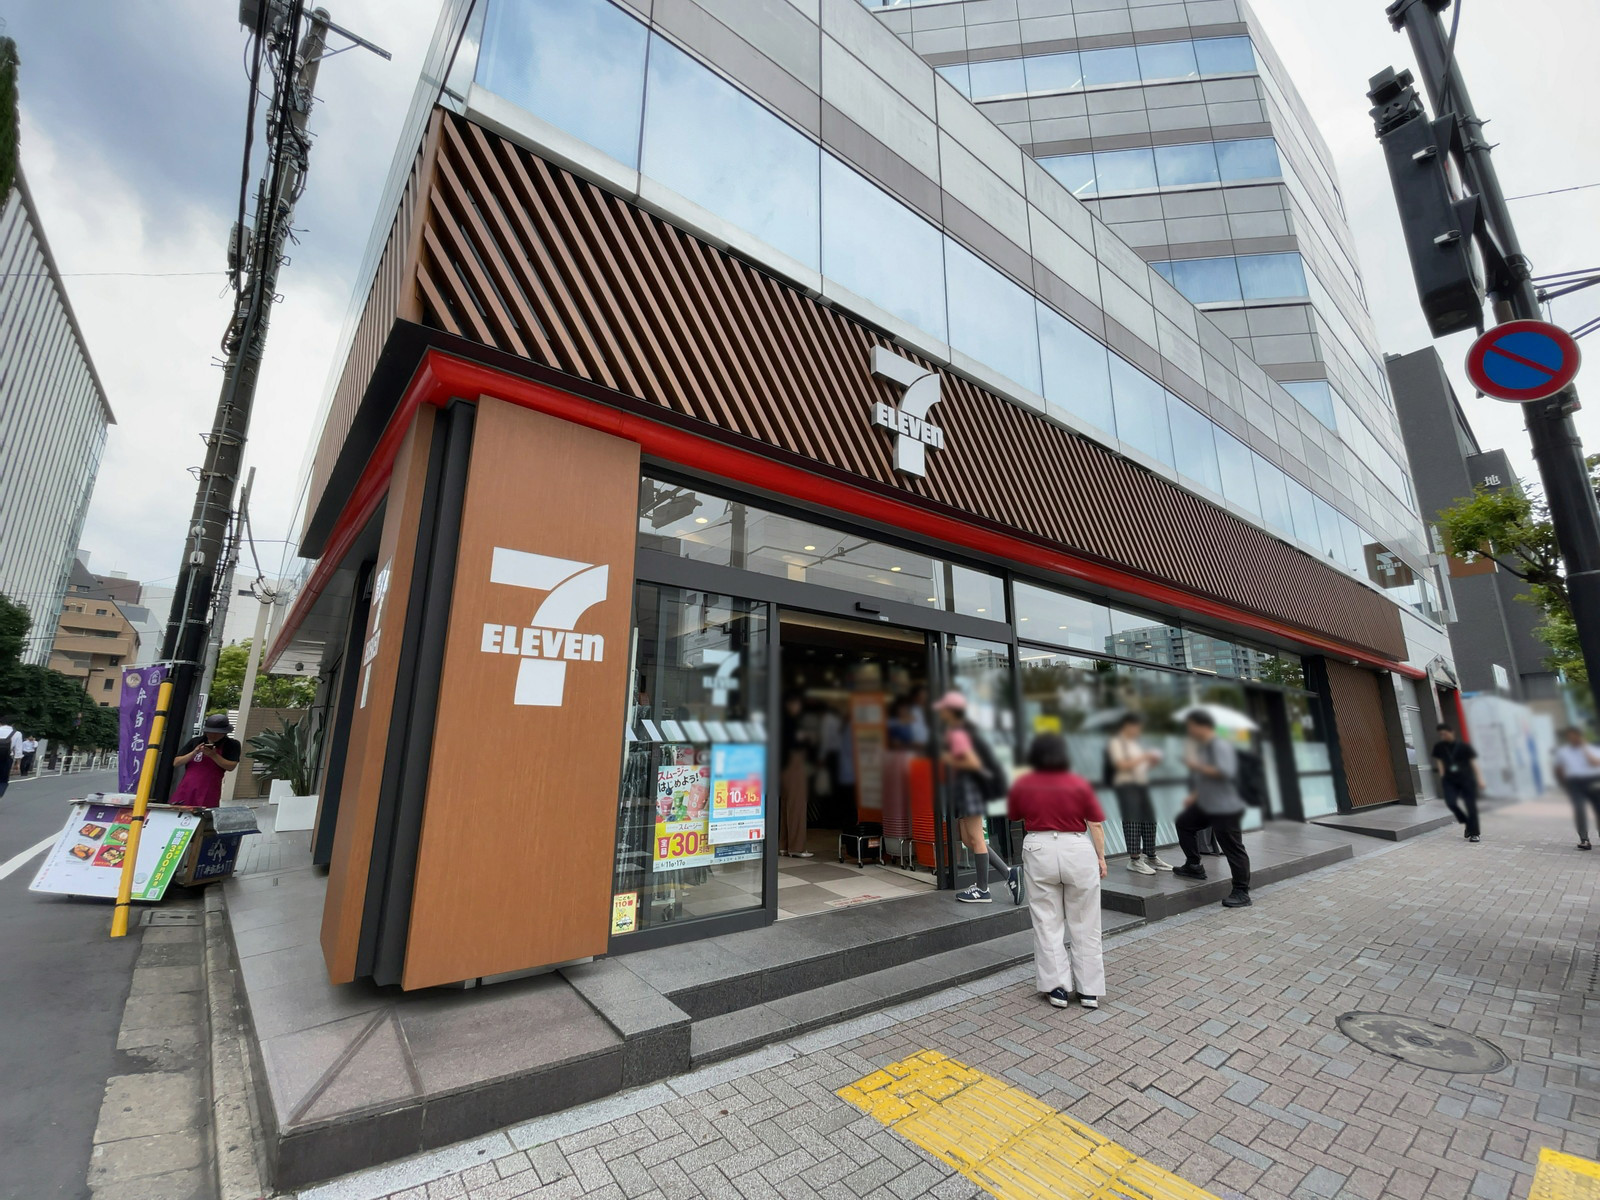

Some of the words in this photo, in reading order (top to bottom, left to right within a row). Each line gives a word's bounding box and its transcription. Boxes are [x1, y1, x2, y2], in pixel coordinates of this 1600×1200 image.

[870, 344, 941, 478] 7
[1484, 474, 1500, 487] 地
[490, 546, 609, 707] 7
[657, 766, 689, 783] スムージー
